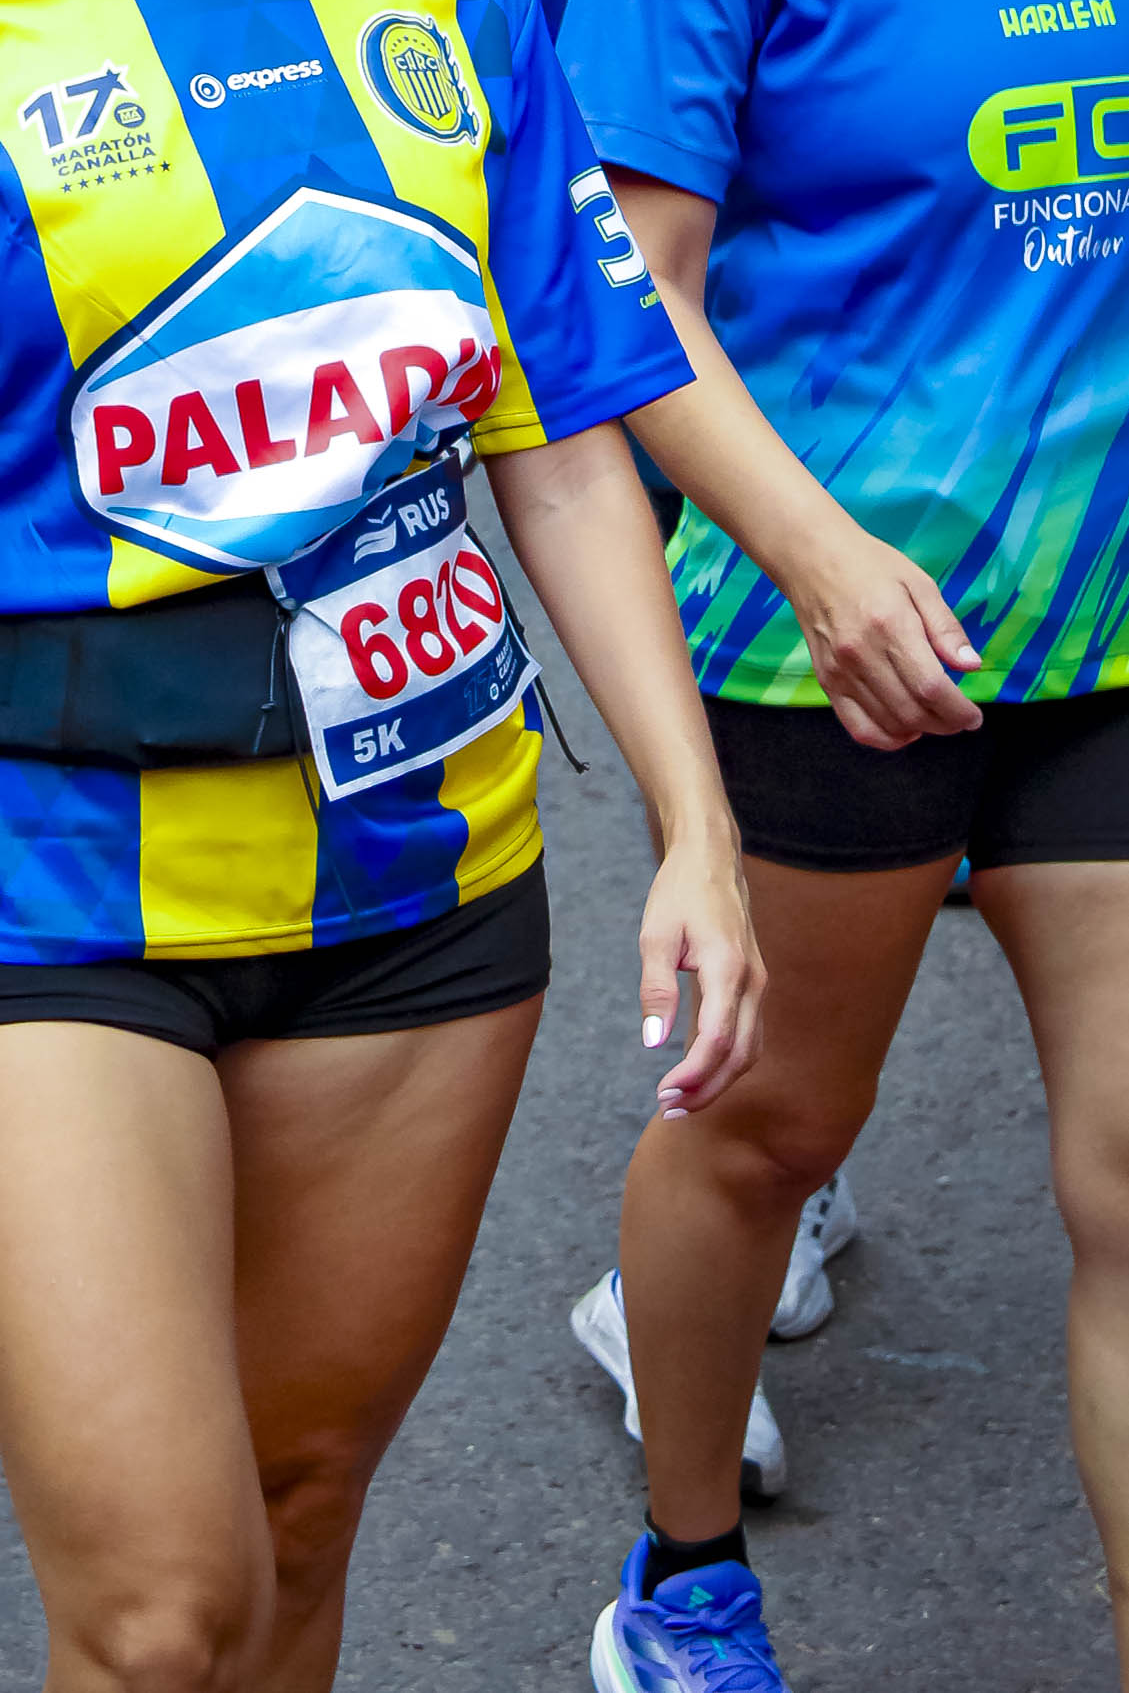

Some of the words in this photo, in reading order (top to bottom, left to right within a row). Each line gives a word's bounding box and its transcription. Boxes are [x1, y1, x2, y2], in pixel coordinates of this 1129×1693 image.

[226, 59, 324, 91] express
[22, 68, 128, 150] 17
[51, 132, 152, 167] MARATÓN
[58, 145, 156, 177] CANALLA
[568, 165, 648, 289] 3
[398, 487, 450, 538] RUS
[352, 716, 407, 764] 5K
